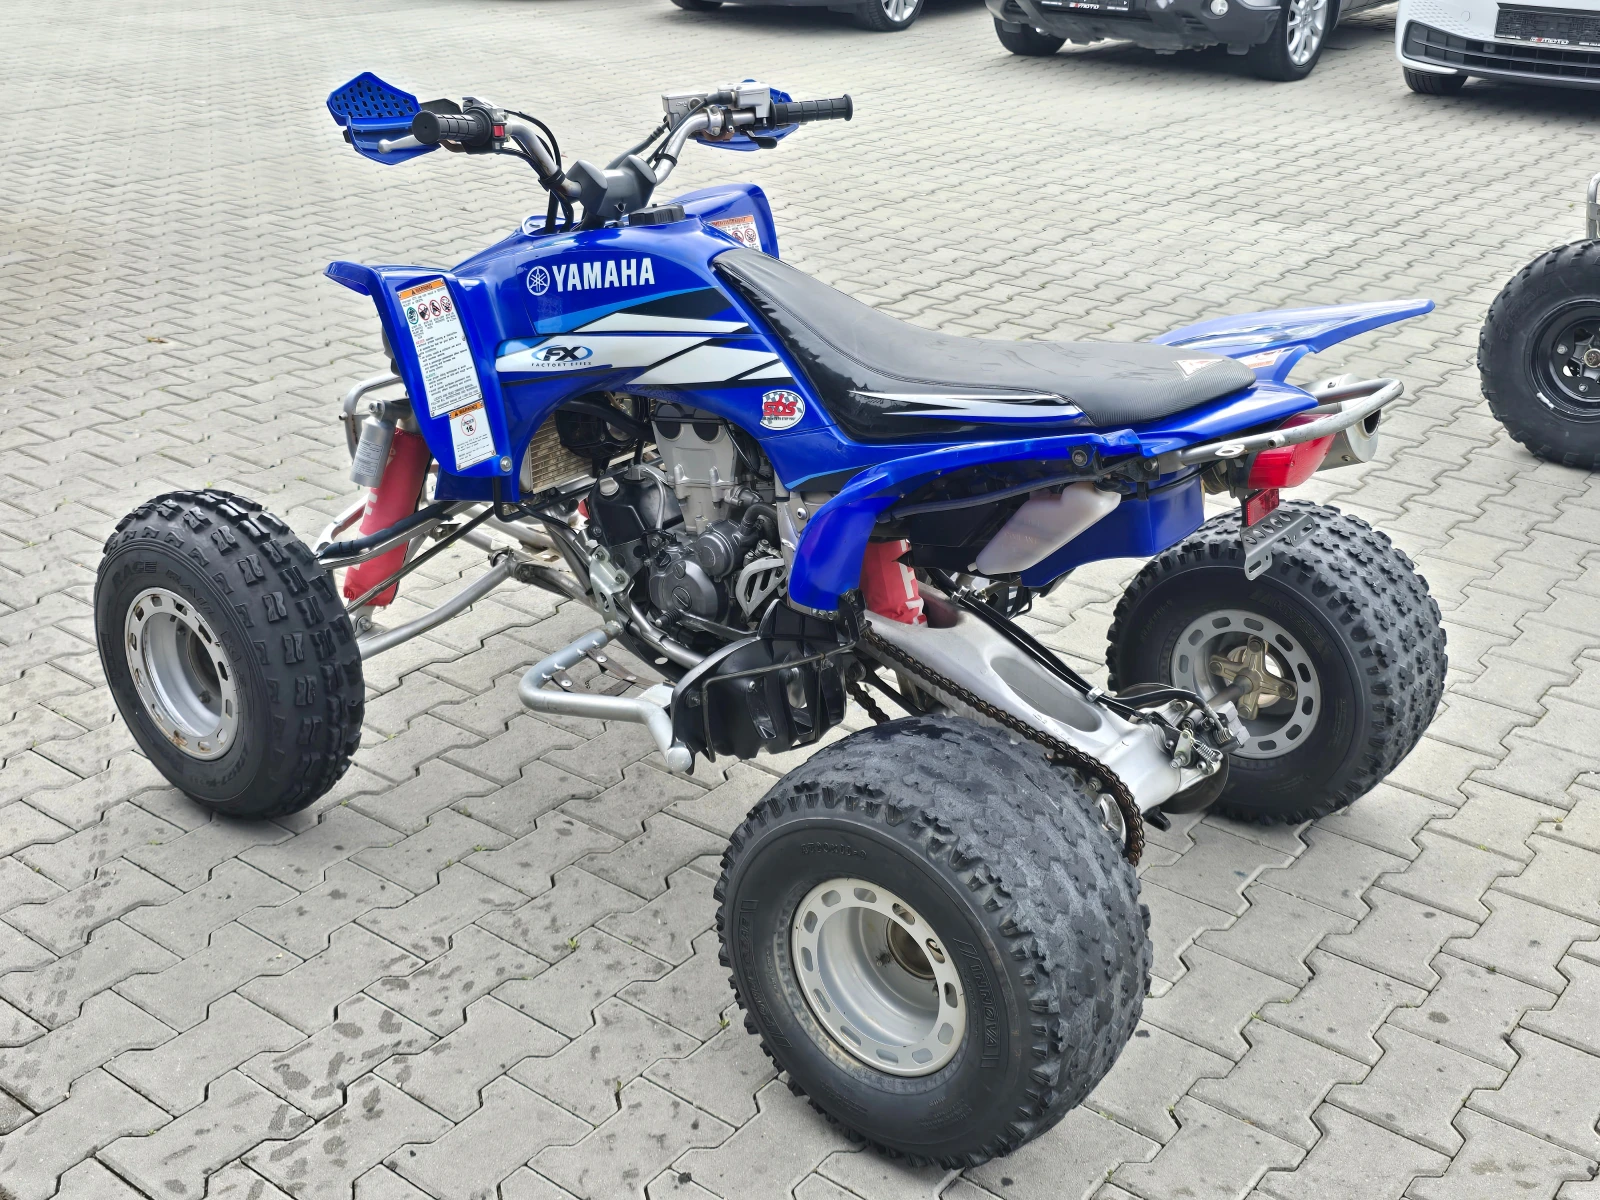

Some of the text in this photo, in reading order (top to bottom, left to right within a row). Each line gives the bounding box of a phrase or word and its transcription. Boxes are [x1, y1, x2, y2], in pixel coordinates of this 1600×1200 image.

[552, 257, 656, 292] YAMAHA
[542, 346, 581, 361] FX
[971, 963, 999, 1048] INNOVA
